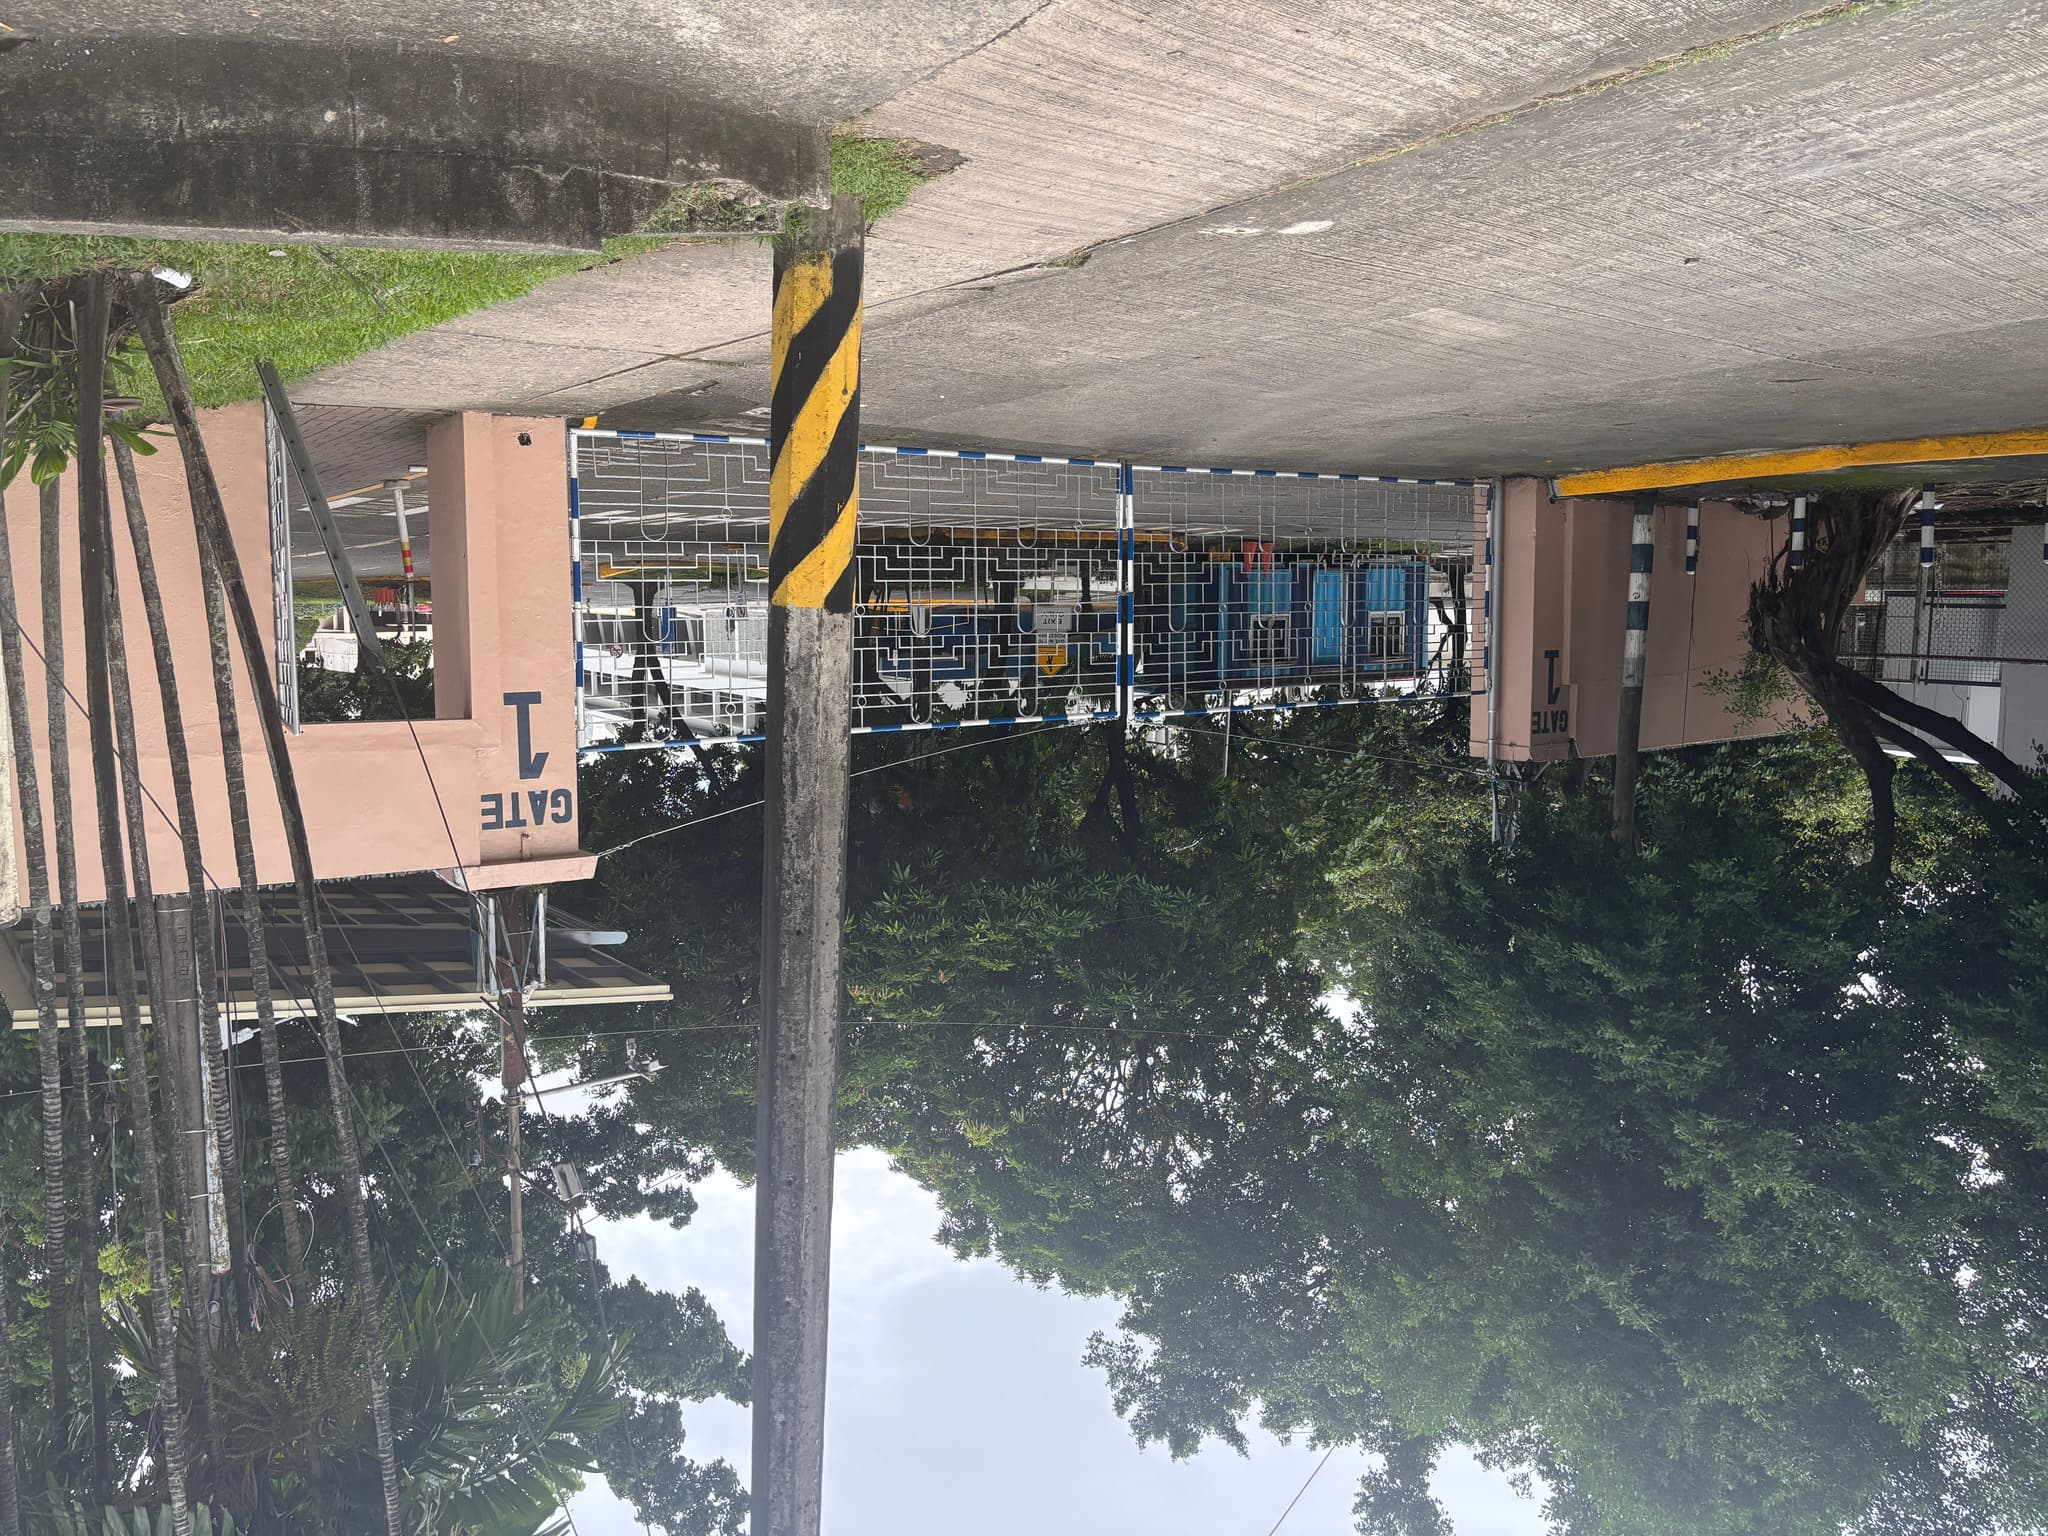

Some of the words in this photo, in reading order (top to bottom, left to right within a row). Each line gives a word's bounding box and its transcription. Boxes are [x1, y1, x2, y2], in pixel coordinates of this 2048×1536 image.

[1543, 649, 1561, 705] 1
[502, 690, 550, 781] 1
[1531, 710, 1568, 735] GATE
[480, 788, 573, 831] GATE
